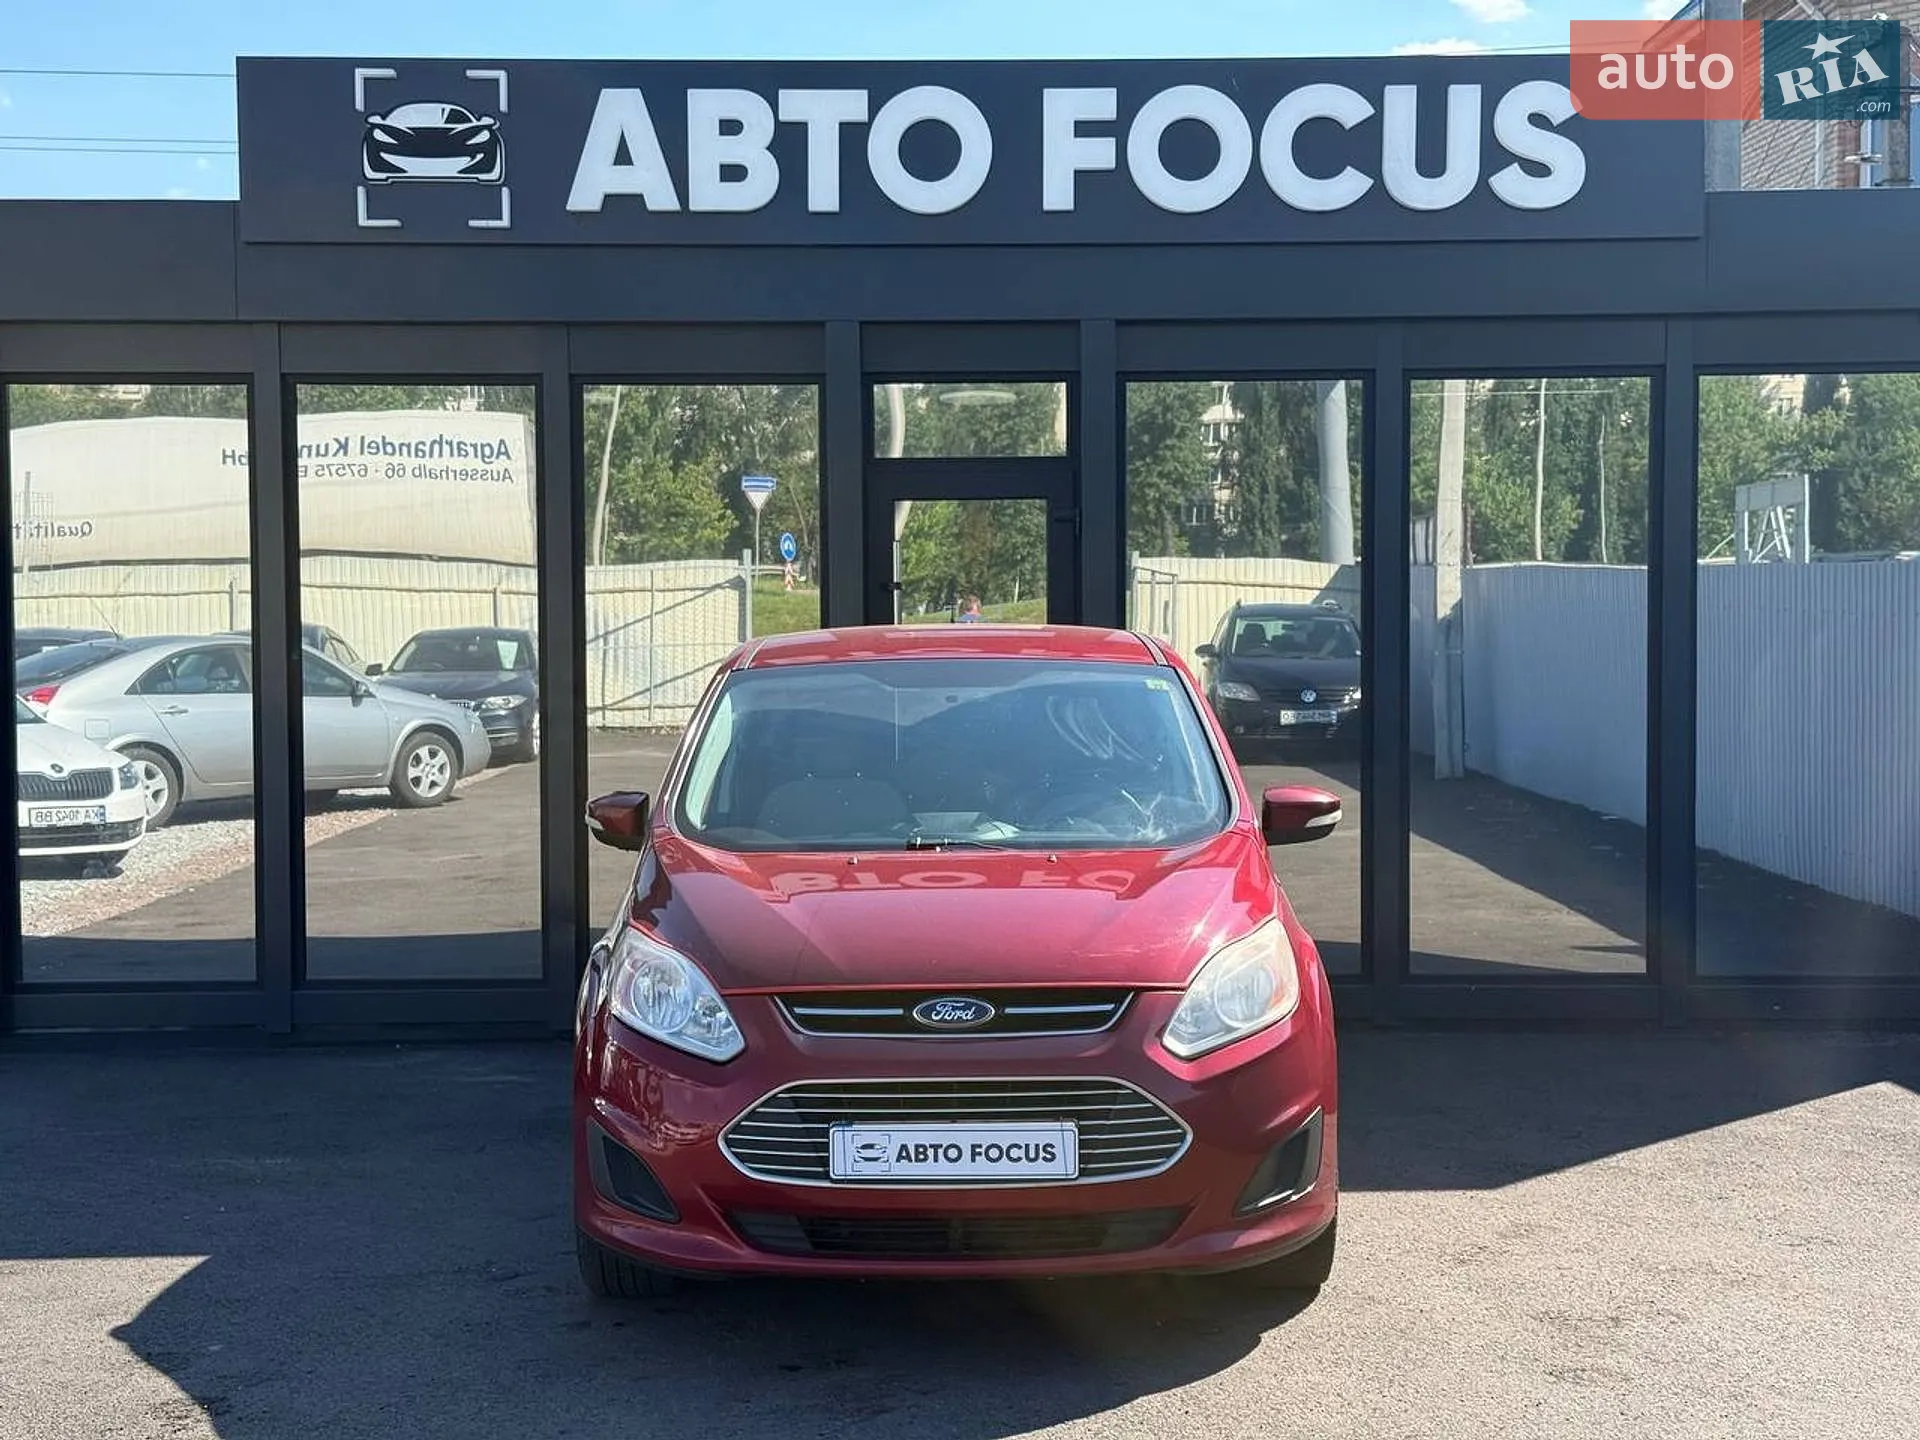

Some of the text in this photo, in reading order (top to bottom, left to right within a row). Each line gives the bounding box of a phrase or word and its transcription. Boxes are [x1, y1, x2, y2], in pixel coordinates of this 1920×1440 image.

[565, 81, 1587, 215] АВТО FOCUS
[931, 1002, 975, 1021] Ford
[895, 1143, 1057, 1163] АВТО FOCUS
